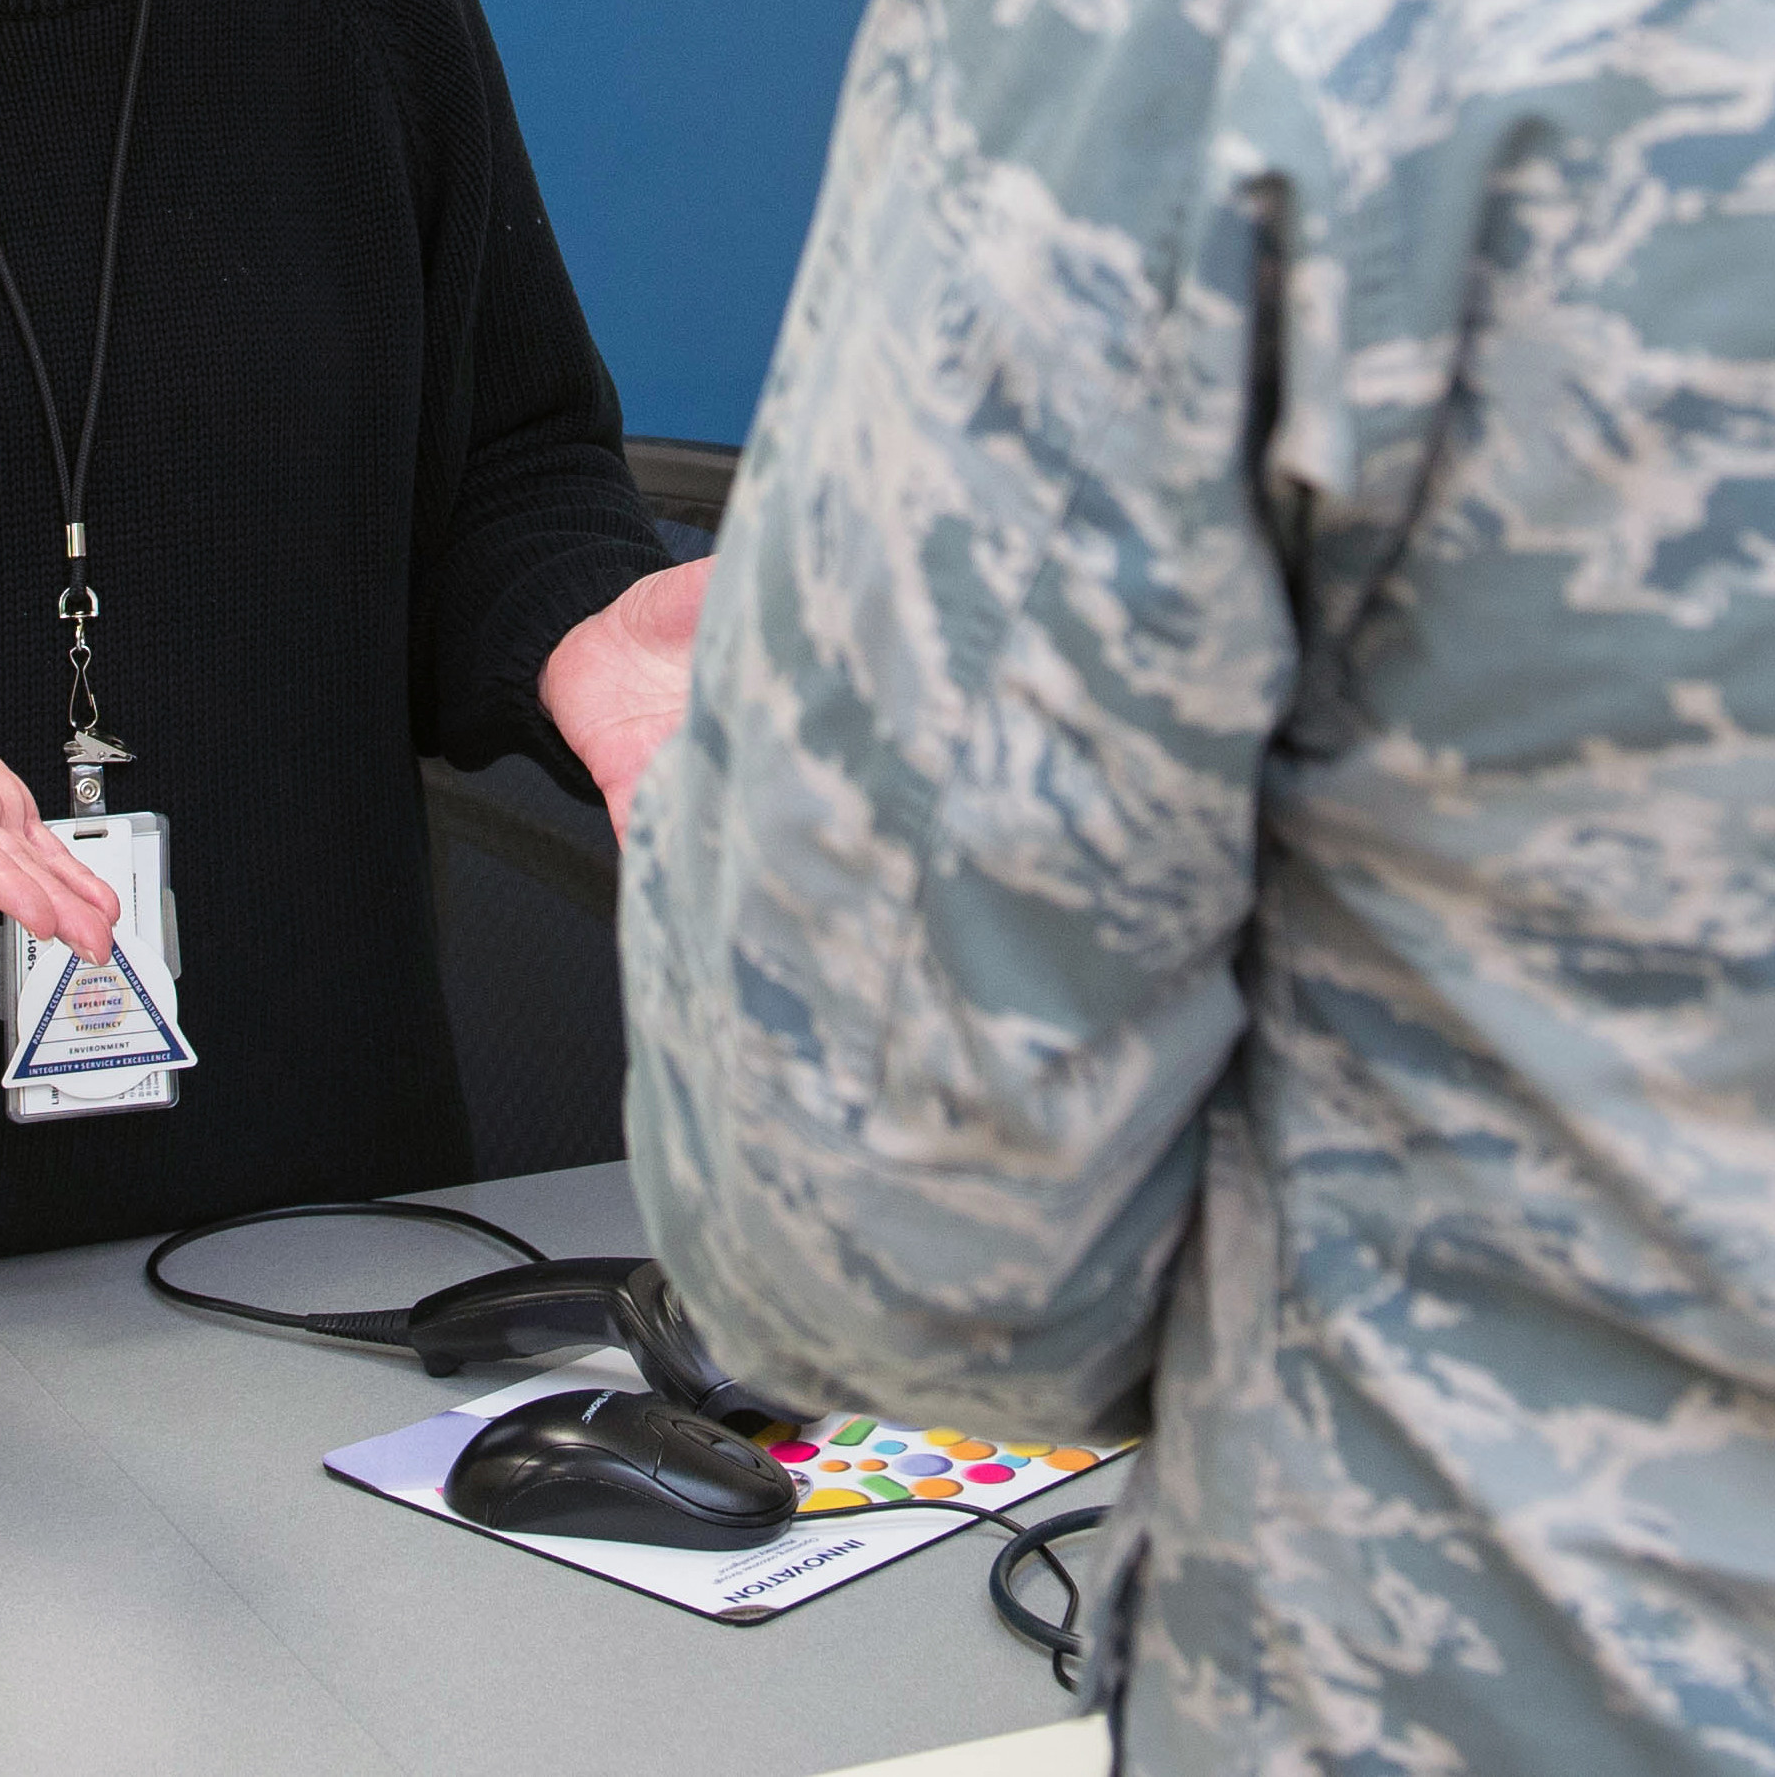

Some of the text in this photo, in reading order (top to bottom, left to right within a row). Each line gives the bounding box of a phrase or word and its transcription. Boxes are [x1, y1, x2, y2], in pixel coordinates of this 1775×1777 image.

[75, 975, 118, 986] COURTESY
[113, 949, 164, 1027] ZERO HARM CULTURE
[32, 954, 79, 1046] PATIENT CENTEREDNE
[73, 998, 123, 1010] EXPERIENCE
[75, 1021, 122, 1032] EFFICIENCY
[69, 1041, 130, 1054] ENVIRONMENT
[29, 1052, 172, 1076] INTEGRITY SERVICE EXCELLENCE
[722, 1538, 866, 1604] INNOVATION
